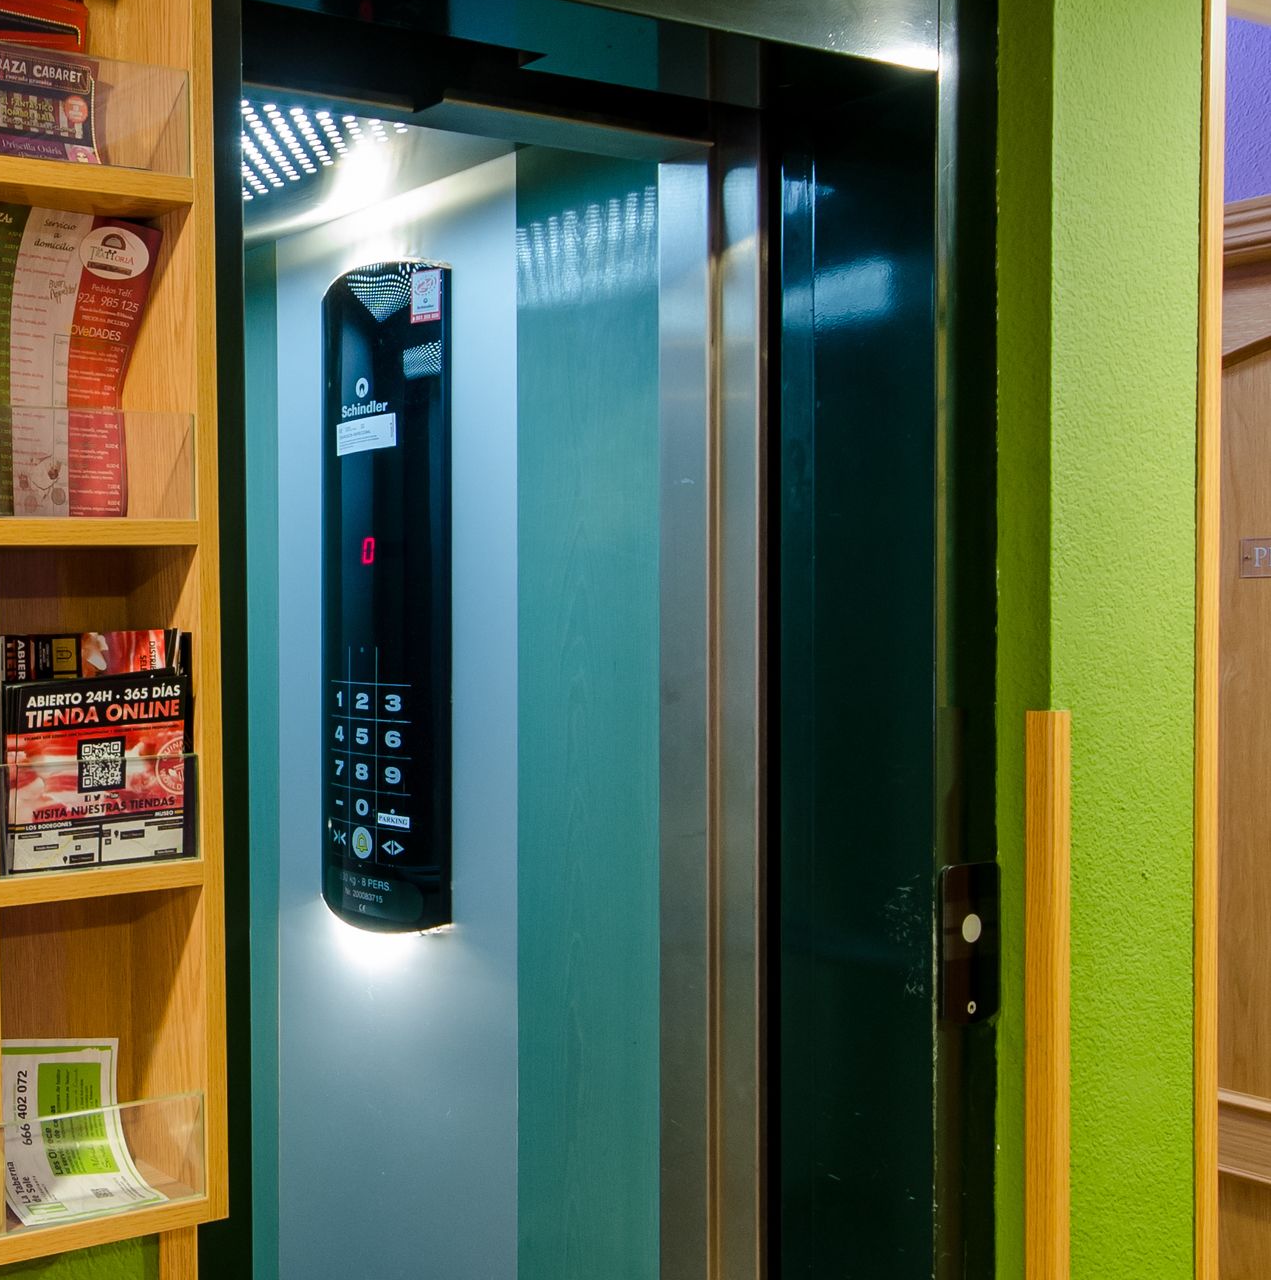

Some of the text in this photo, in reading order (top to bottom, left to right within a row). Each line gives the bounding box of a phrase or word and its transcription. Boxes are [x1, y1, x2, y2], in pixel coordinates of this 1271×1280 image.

[33, 65, 82, 83] CABARET
[44, 219, 76, 230] Servicio
[34, 239, 74, 252] domicilio
[79, 292, 139, 313] 924 985 125
[72, 325, 122, 341] OVeDADES
[342, 400, 388, 418] Schindler
[361, 536, 375, 565] 0
[26, 683, 181, 709] ABIERTO 24H 365 DÍAS
[337, 691, 402, 712] 1 2 3
[26, 699, 180, 729] TIENDA ONLINE
[335, 725, 402, 748] 4 5 6
[335, 760, 401, 784] 7 8 9
[32, 796, 175, 820] VISITA NUESTRAS TIENDAS
[356, 799, 369, 816] 0
[38, 822, 72, 830] BODEGONES
[379, 815, 409, 826] PARKING
[368, 879, 392, 892] PERS.
[17, 1070, 33, 1145] 666 402 072
